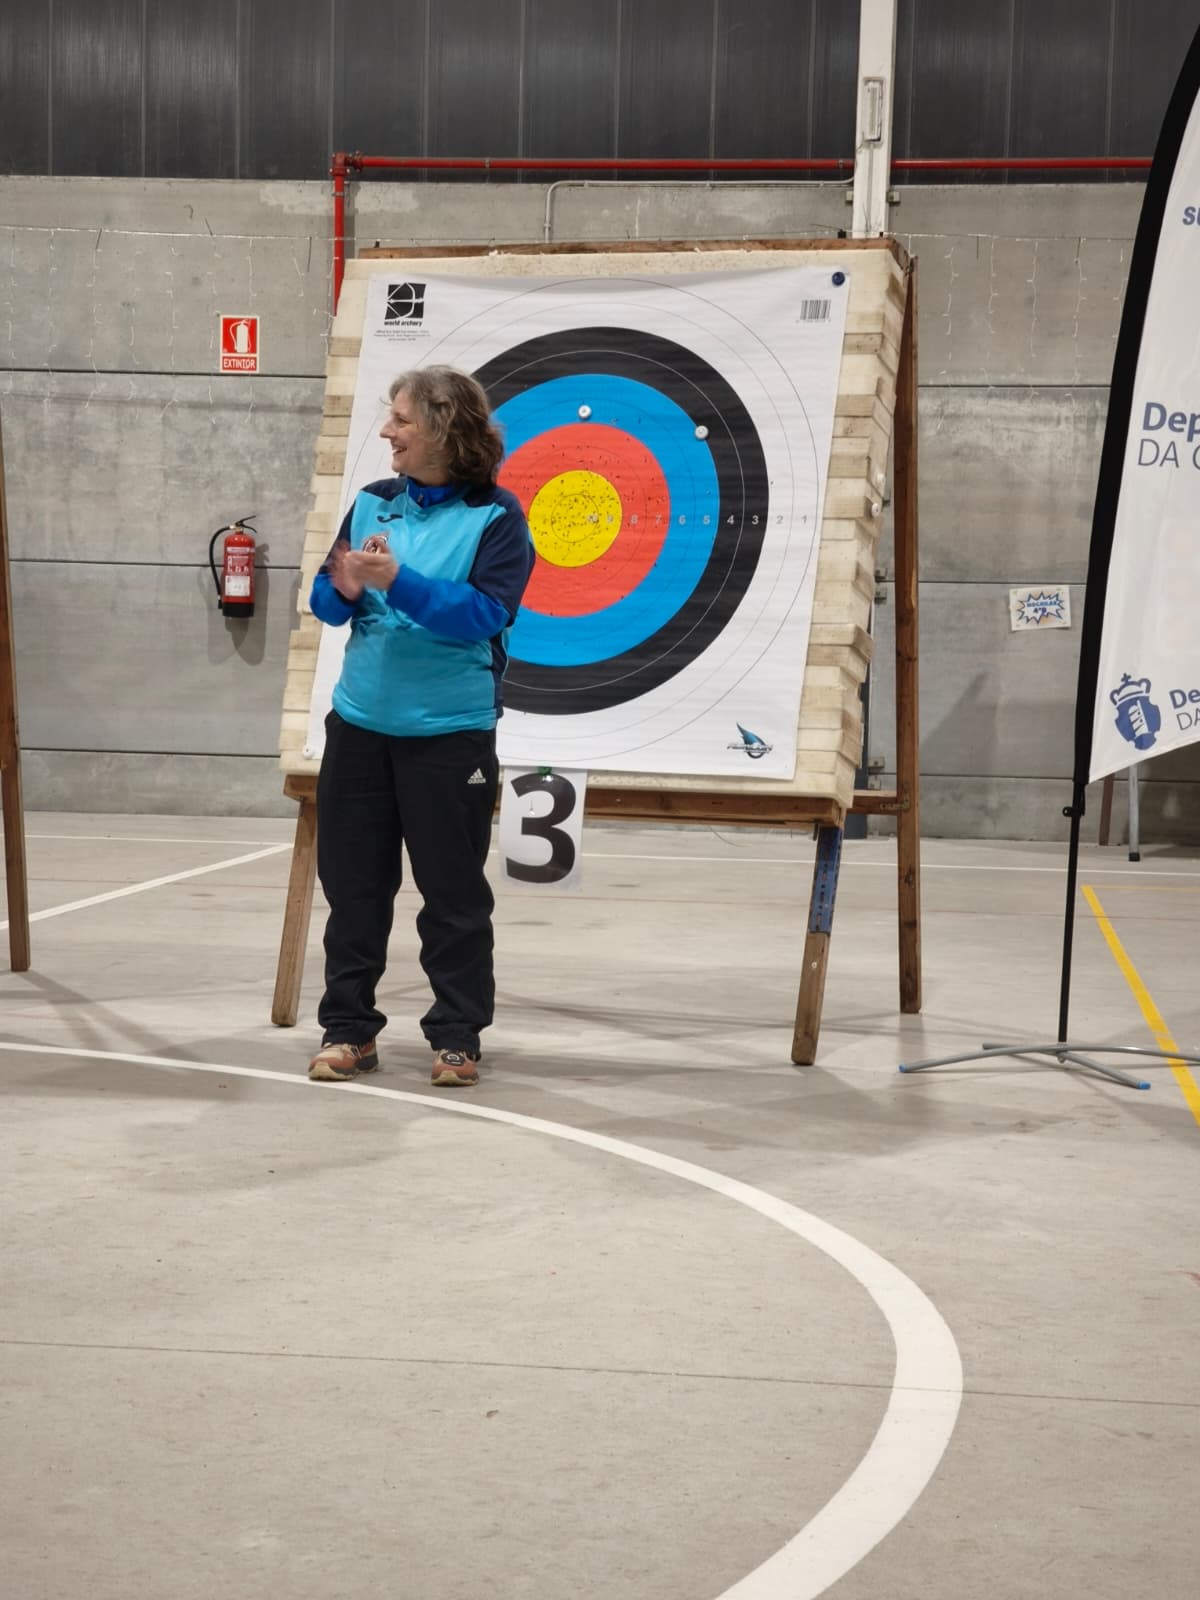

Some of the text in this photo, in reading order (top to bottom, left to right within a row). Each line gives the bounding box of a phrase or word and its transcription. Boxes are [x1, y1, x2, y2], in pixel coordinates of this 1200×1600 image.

[1182, 206, 1200, 226] S
[223, 358, 256, 369] EXTINTOR
[1138, 439, 1179, 468] DA
[630, 514, 639, 525] 8
[655, 514, 662, 525] 7
[678, 514, 686, 525] 6
[703, 515, 711, 525] 5
[727, 515, 735, 525] 4
[752, 515, 759, 525] 3
[776, 515, 783, 525] 2
[801, 515, 807, 524] 1
[506, 773, 576, 884] 3
